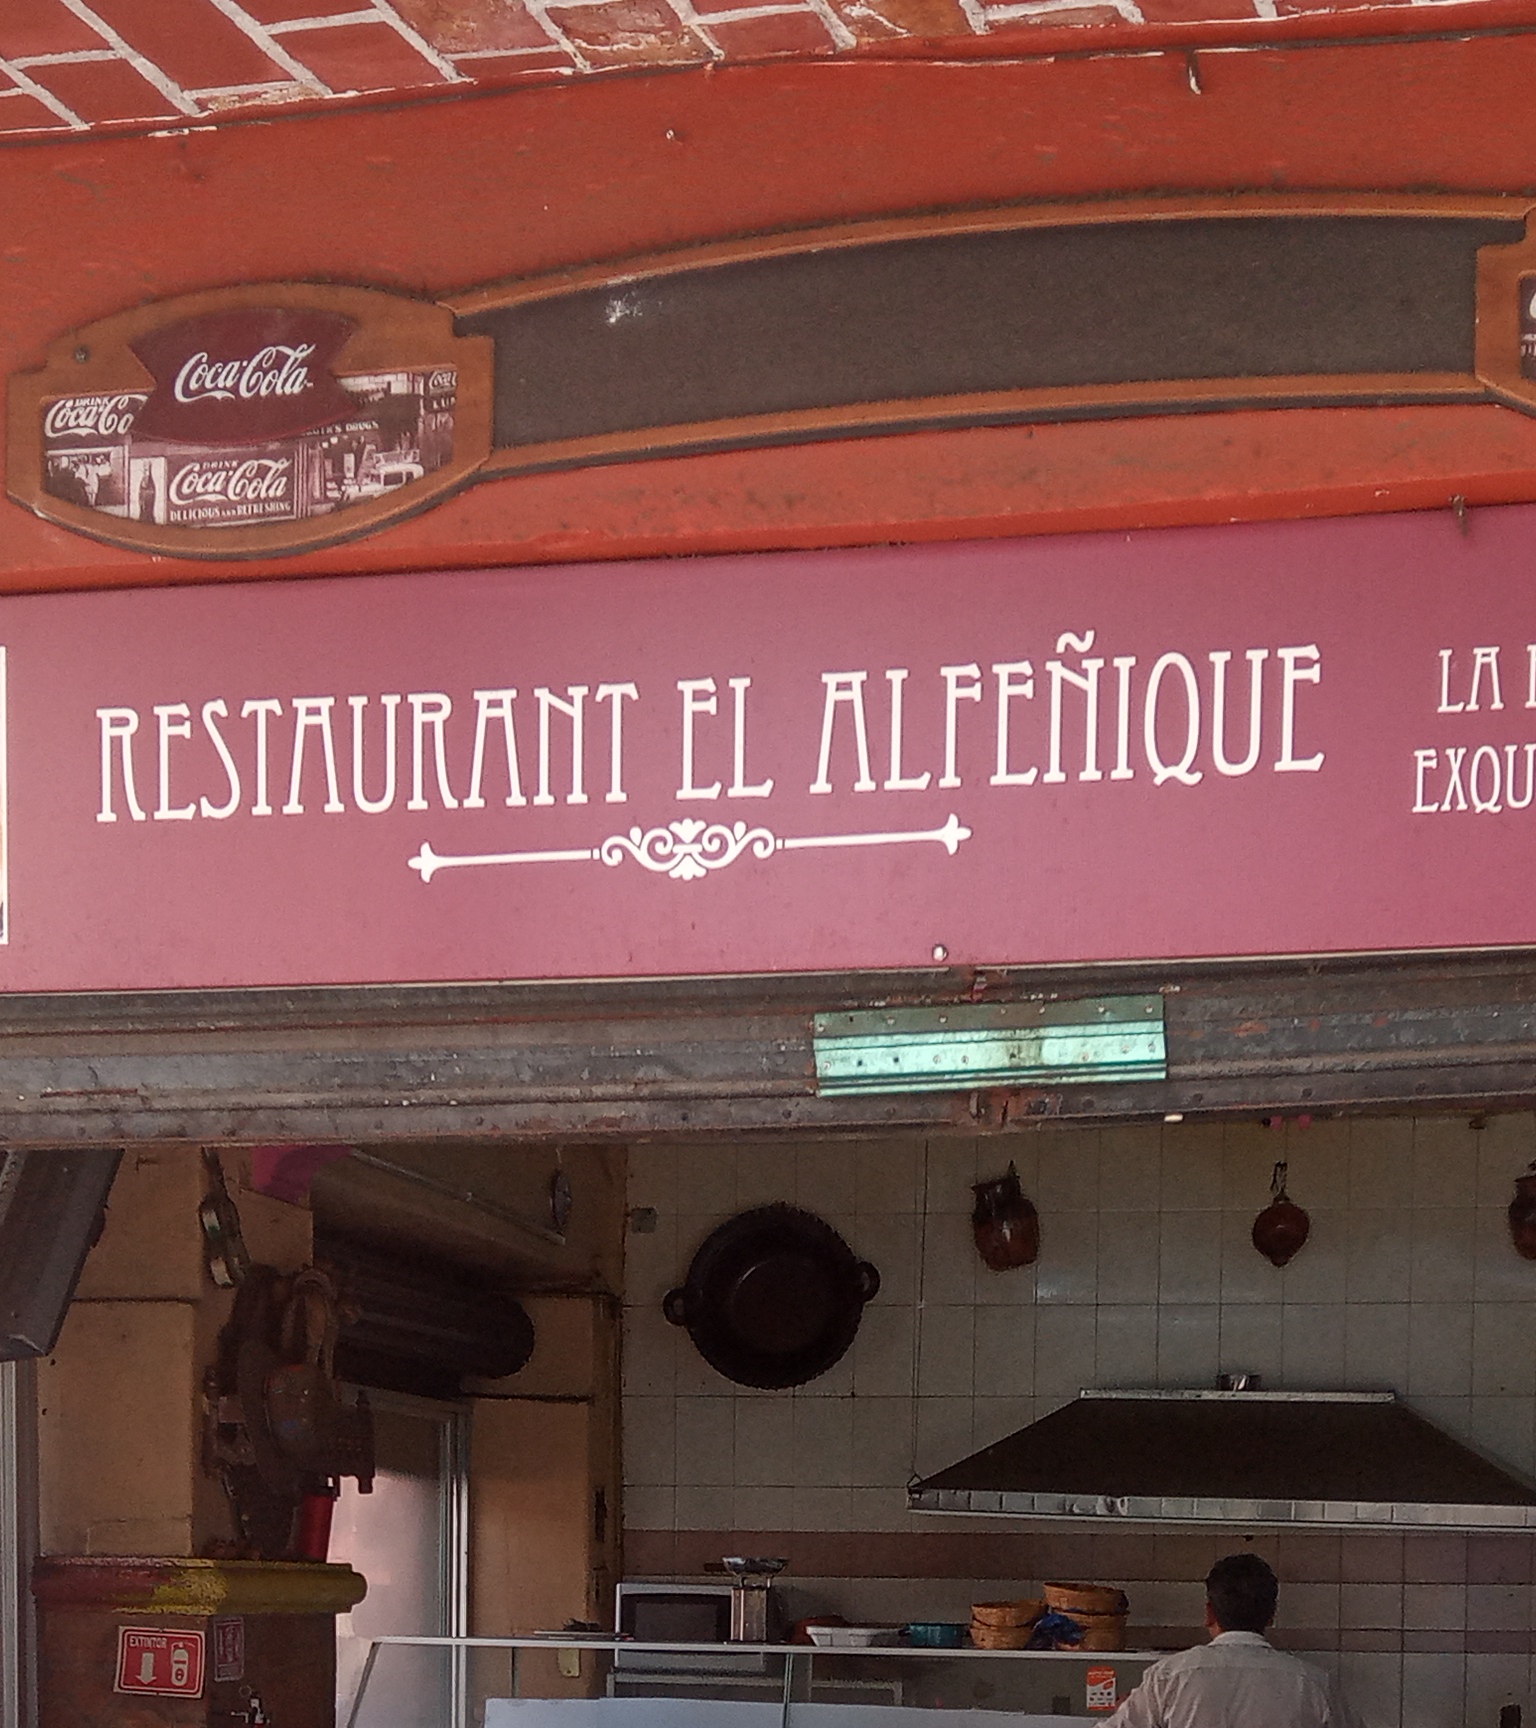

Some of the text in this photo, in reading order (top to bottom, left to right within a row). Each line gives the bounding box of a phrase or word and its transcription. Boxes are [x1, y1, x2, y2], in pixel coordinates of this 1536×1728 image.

[175, 343, 316, 403] Coca-Cola
[44, 394, 149, 438] Coca-Co
[345, 420, 379, 432] DRUGS
[169, 457, 293, 505] Coca-Cola
[202, 460, 239, 469] DRINK
[170, 507, 221, 521] DELICIOUS
[237, 501, 292, 515] REFRESHING
[1437, 647, 1505, 712] LA
[96, 631, 1326, 823] RESTAURANT EL ALFEÑIQUE
[129, 1635, 167, 1648] EXTINTOR
